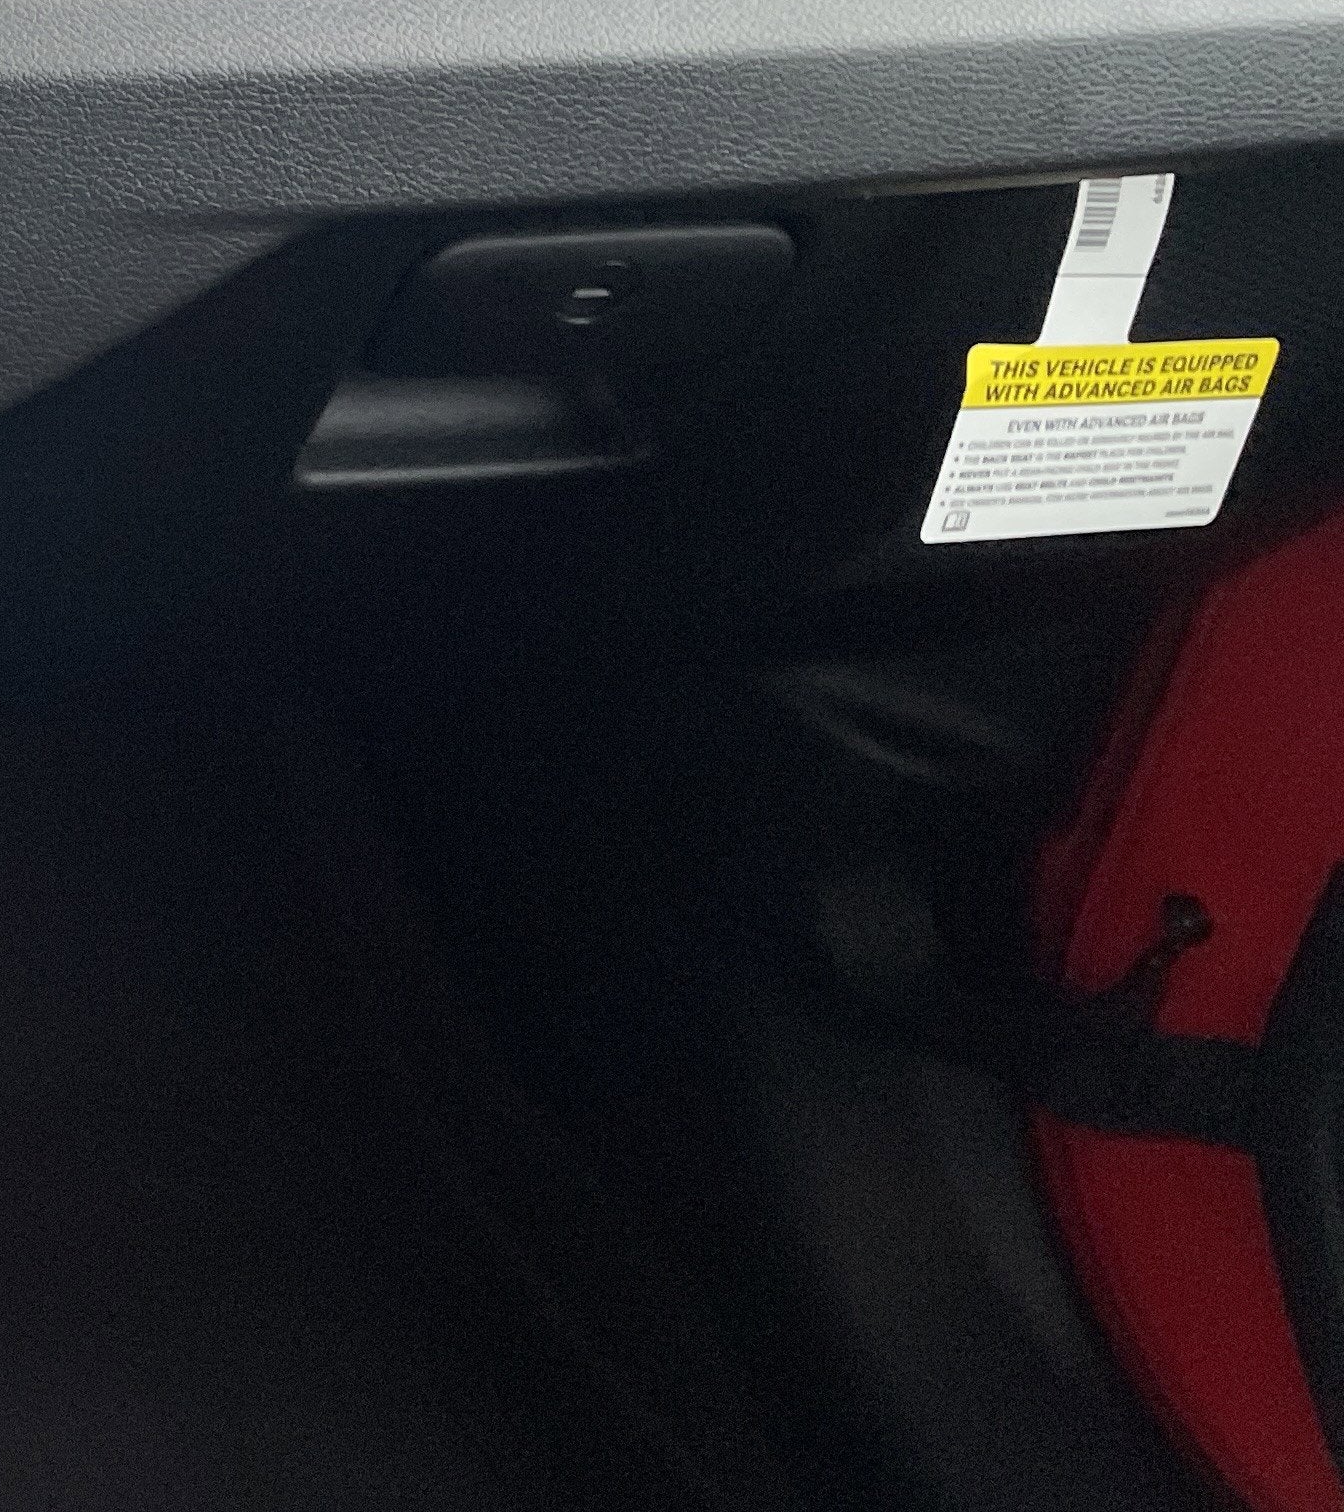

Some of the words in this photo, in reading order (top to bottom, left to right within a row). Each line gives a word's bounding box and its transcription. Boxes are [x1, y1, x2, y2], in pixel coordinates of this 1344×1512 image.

[991, 359, 1039, 380] THIS
[1046, 357, 1133, 378] VEHICLE
[1137, 356, 1153, 374] IS
[1160, 353, 1259, 373] EQUIPPED
[985, 383, 1038, 403] WITH
[1044, 379, 1156, 400] ADVANCED
[1160, 377, 1195, 395] AIR
[1199, 375, 1252, 394] BAGS
